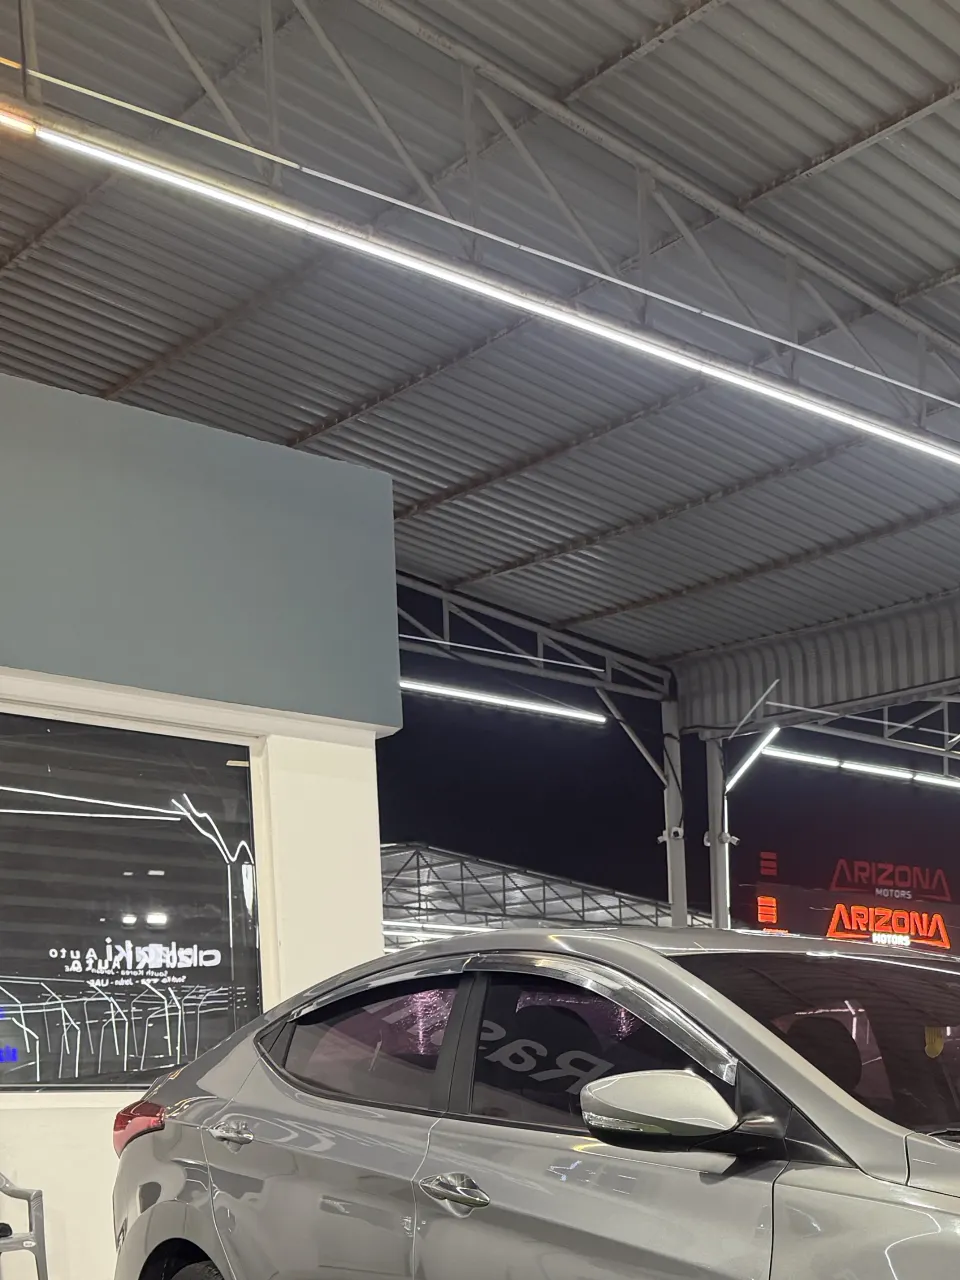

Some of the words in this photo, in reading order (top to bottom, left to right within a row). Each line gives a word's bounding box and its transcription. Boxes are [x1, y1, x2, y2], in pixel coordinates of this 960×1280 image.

[829, 858, 951, 901] ARIZONA
[875, 887, 912, 900] MOTORS
[826, 903, 950, 949] ARIZONA
[871, 932, 911, 946] MOTORS
